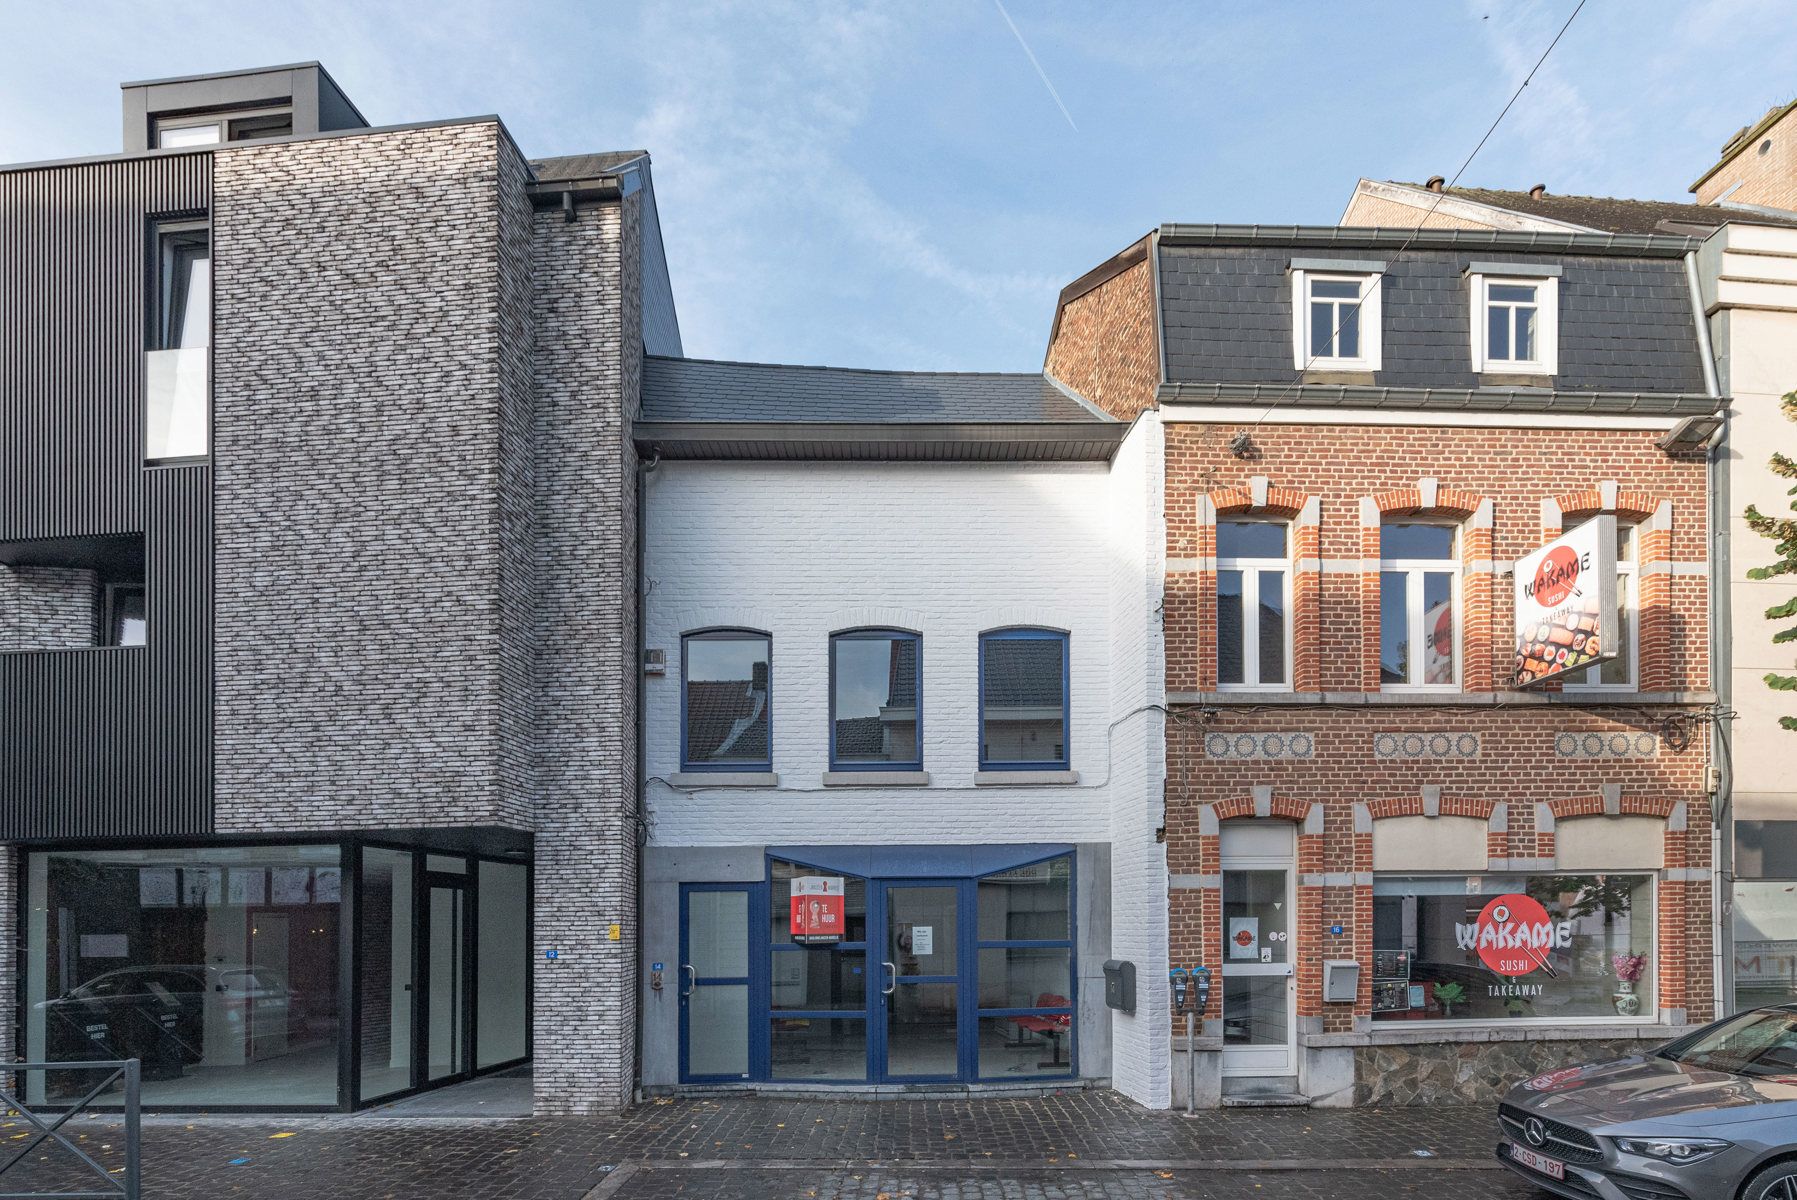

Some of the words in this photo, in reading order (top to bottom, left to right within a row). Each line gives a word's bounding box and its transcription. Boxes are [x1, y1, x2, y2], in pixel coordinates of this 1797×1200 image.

[1524, 552, 1591, 600] WAKAME
[1547, 590, 1565, 606] SUSHI
[821, 904, 828, 913] TE
[1455, 921, 1573, 951] WAKAME
[1500, 960, 1528, 972] SUSHI
[1488, 984, 1543, 997] TAKEAWAY
[86, 1023, 109, 1032] BESTEL
[90, 1032, 105, 1040] HIER
